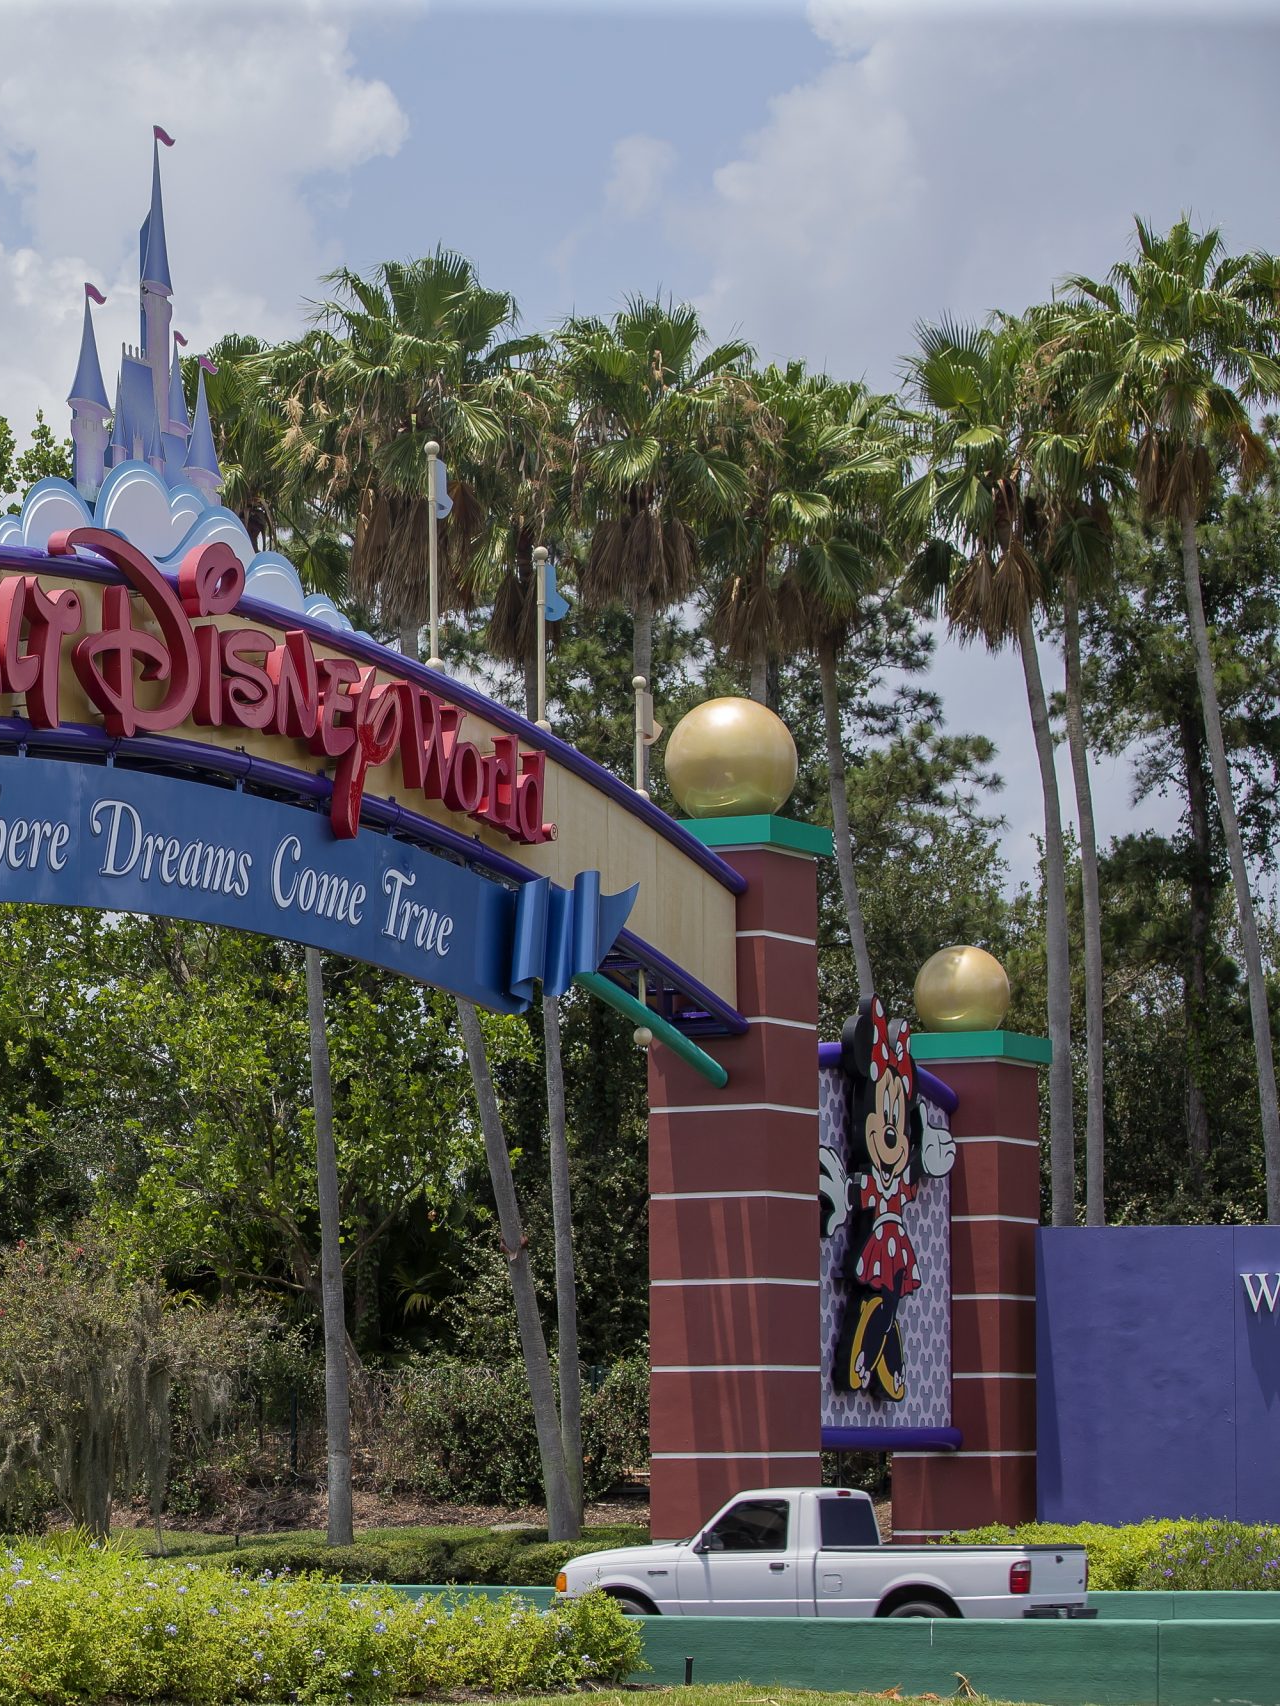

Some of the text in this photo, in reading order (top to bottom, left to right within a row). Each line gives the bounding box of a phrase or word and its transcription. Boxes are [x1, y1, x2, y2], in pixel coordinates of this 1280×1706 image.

[90, 798, 253, 898] Dreams
[271, 833, 367, 927] Come
[382, 866, 455, 957] True
